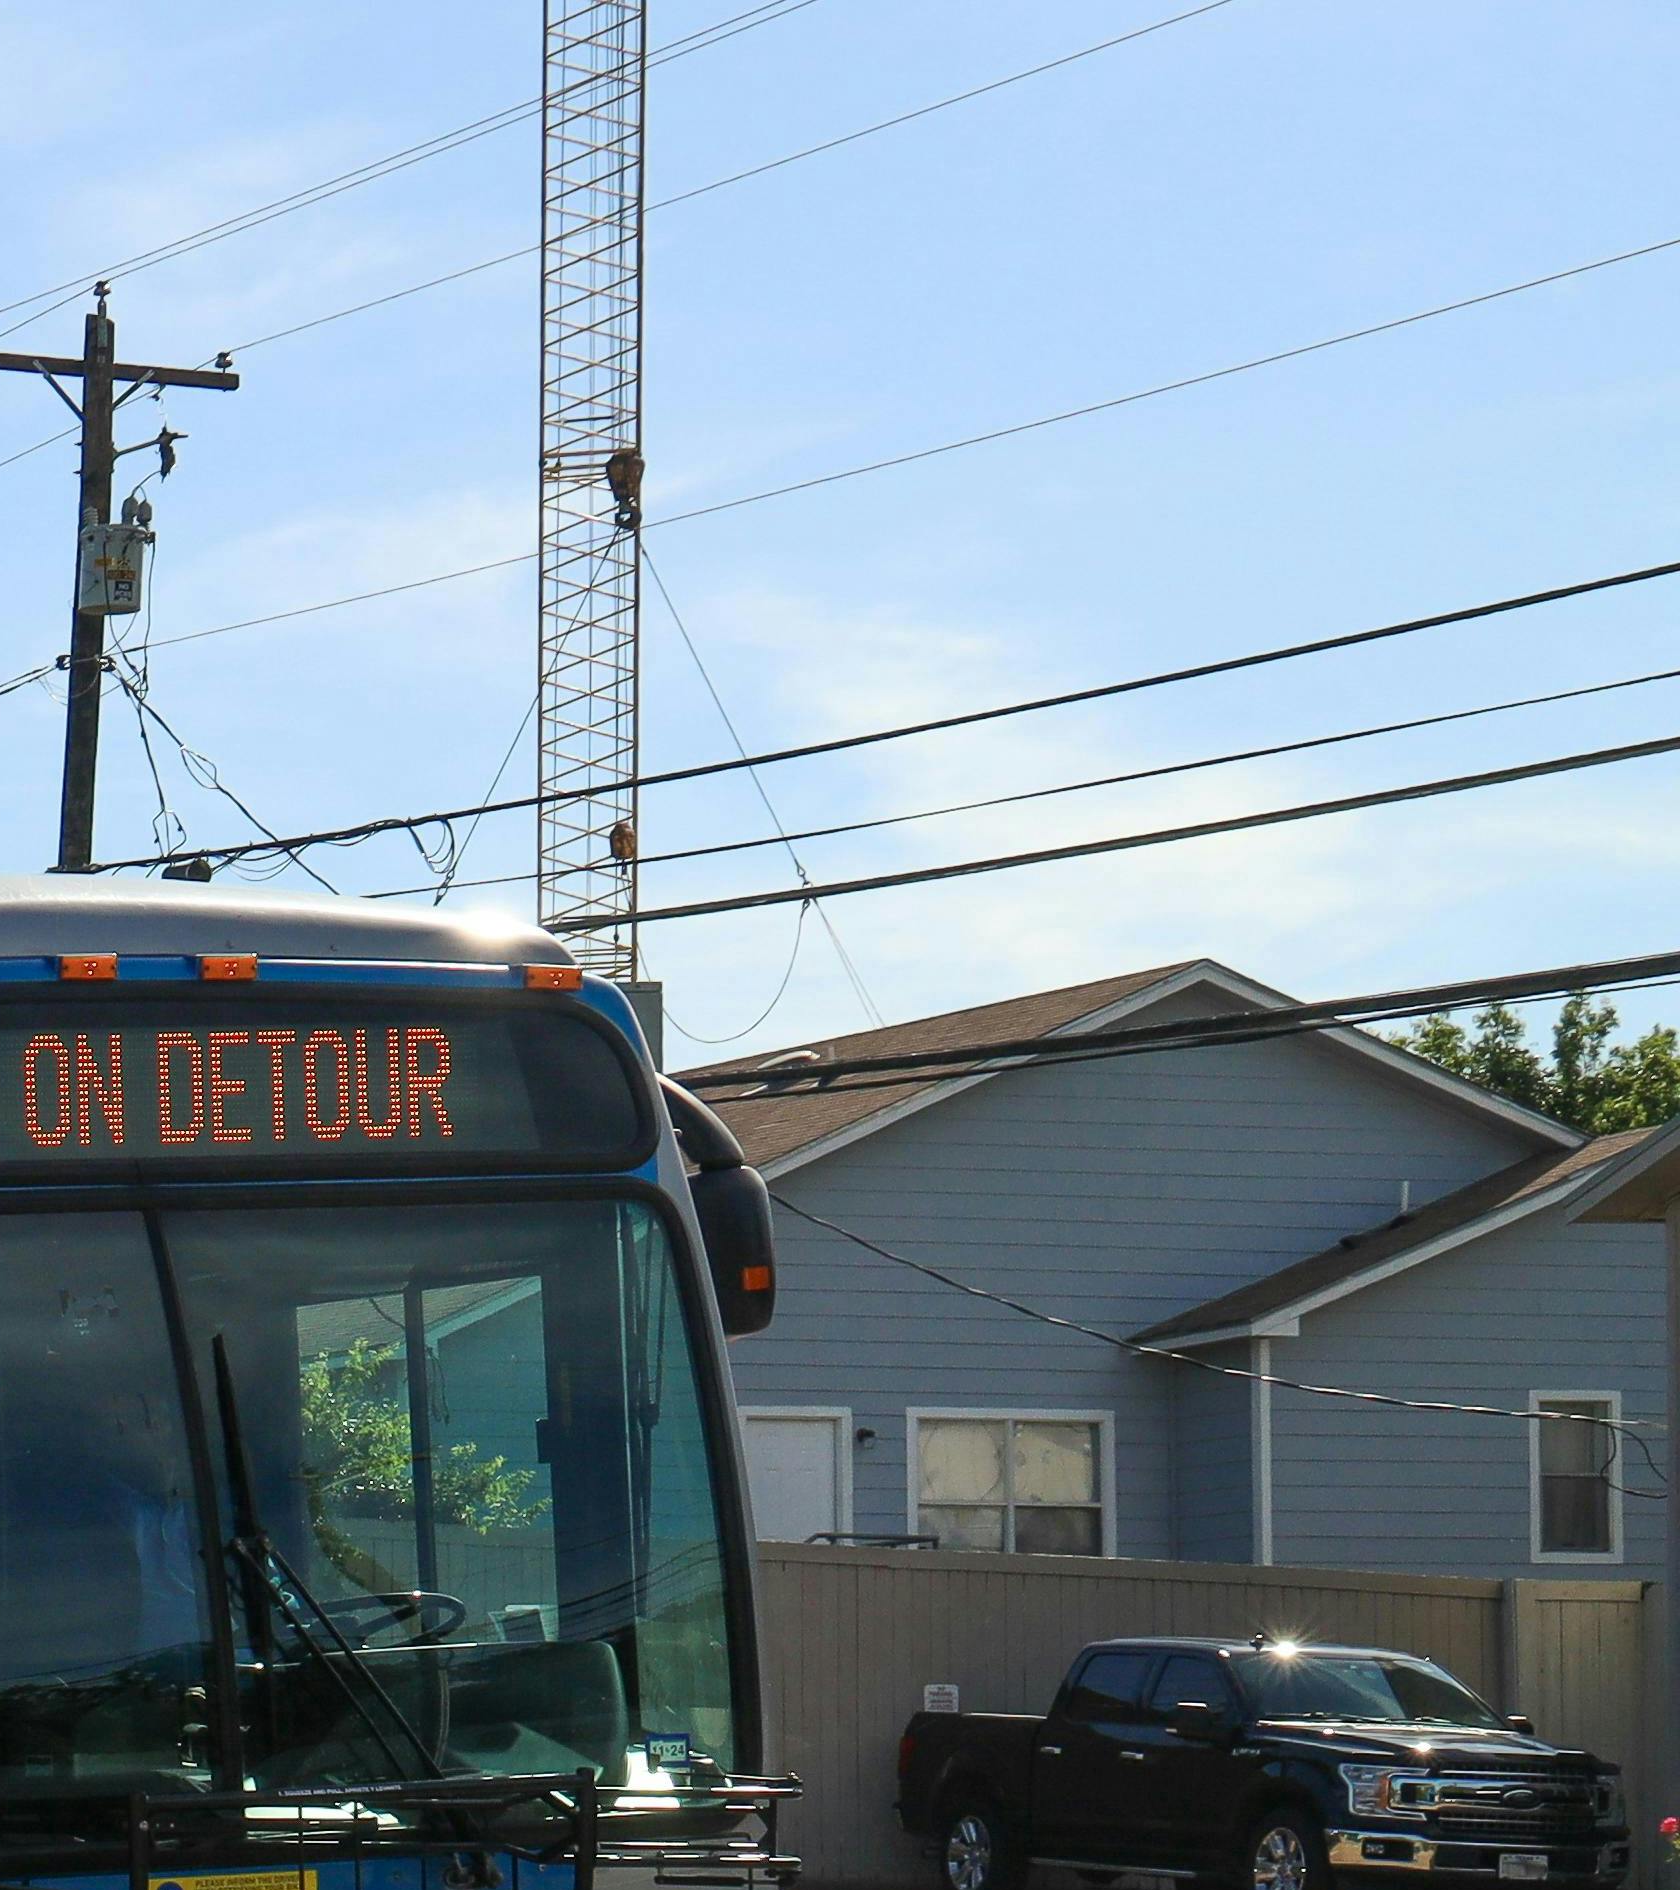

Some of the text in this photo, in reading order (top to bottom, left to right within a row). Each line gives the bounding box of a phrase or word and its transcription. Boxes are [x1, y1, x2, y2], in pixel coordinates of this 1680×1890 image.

[23, 1033, 125, 1147] ON
[159, 1027, 454, 1145] DETOUR
[670, 1744, 685, 1756] 24
[195, 1879, 225, 1888] PLEASE
